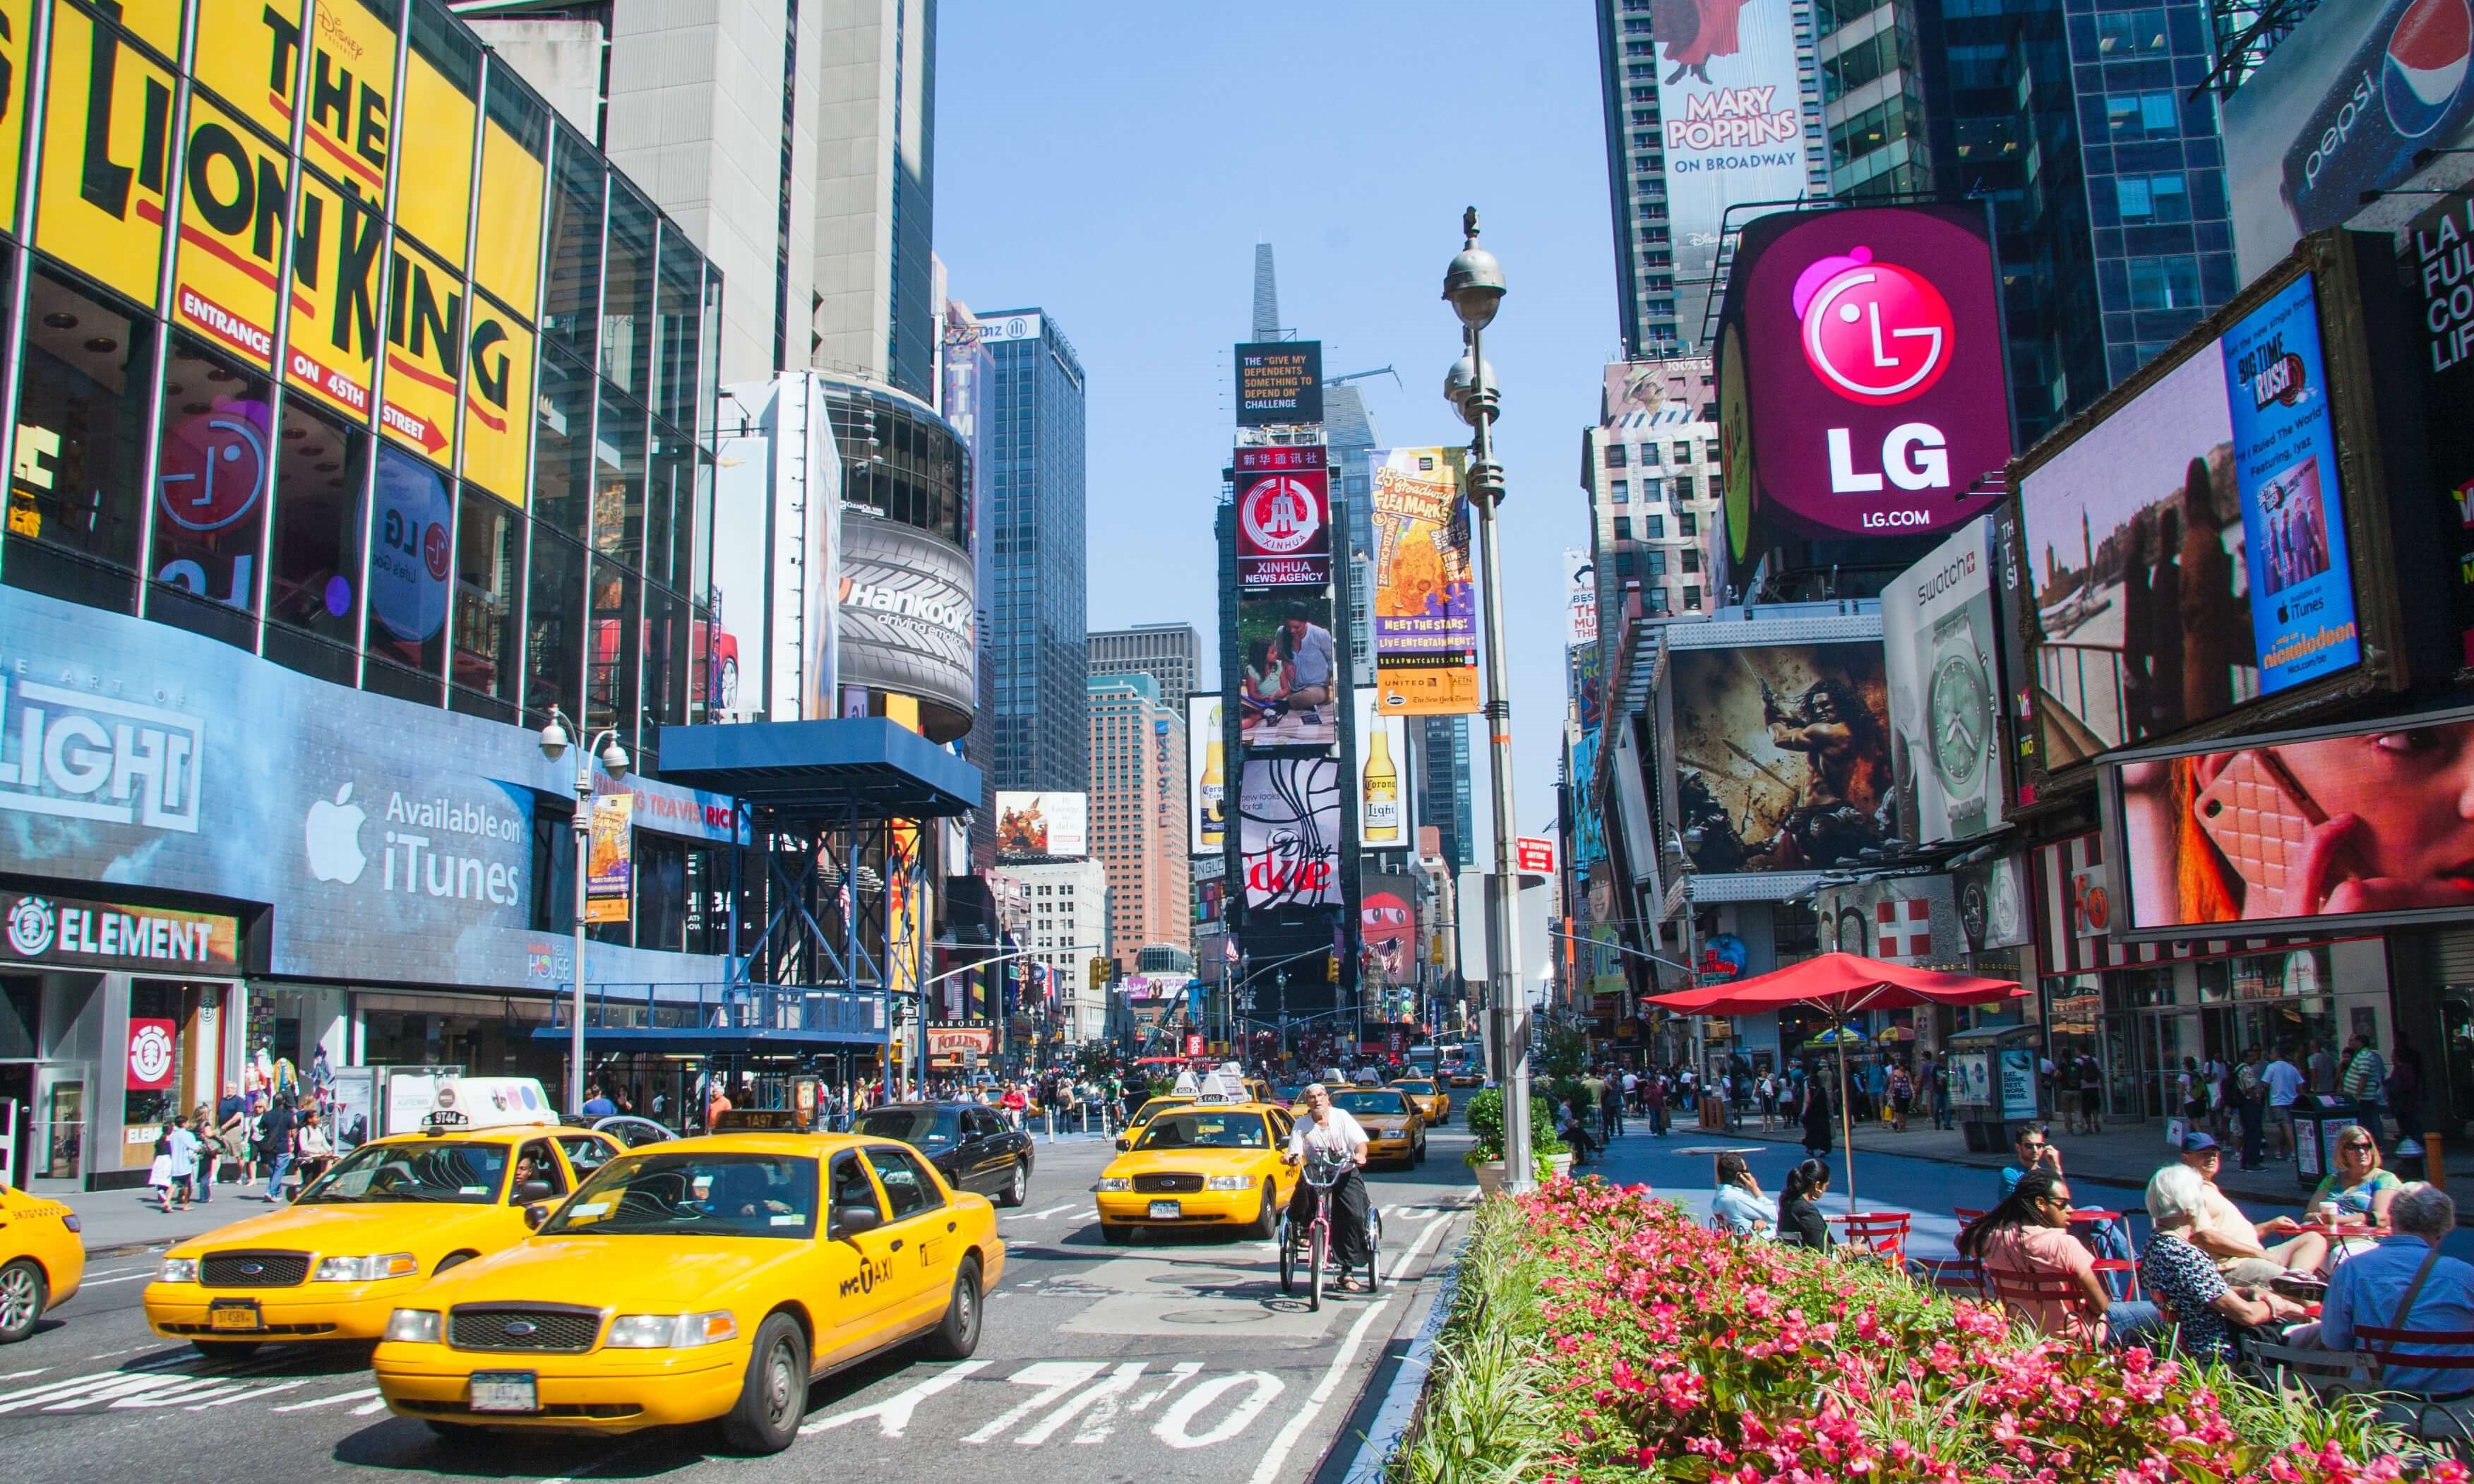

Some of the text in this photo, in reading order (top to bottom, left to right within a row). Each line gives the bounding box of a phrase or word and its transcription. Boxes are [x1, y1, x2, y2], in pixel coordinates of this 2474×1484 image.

[263, 5, 389, 171] THE
[1686, 85, 1778, 121] MARY
[1666, 109, 1798, 150] POPPINS
[2305, 69, 2374, 191] pepsi
[80, 0, 323, 292] LION
[1675, 152, 1796, 174] ON BROADWAY
[332, 176, 510, 411] KING
[184, 293, 270, 356] ENTRANCE
[2269, 308, 2292, 329] single
[1244, 357, 1262, 366] THE
[1292, 355, 1307, 365] MY
[1244, 366, 1303, 376] DEPENDENTS
[294, 356, 365, 408] ON 45TH
[1245, 376, 1312, 388] SOMETHING TO
[1245, 388, 1281, 398] DEPEND
[2254, 356, 2290, 405] RUSH
[1245, 399, 1297, 409] CHALLENGE
[382, 405, 425, 442] STREET
[2252, 433, 2276, 455] Ruled
[2276, 426, 2293, 441] The
[1243, 452, 1318, 466] 新华通讯社
[1827, 422, 1950, 493] LG
[1372, 489, 1456, 524] FLEA MARKET
[1863, 510, 1930, 528] LG.COM
[1263, 534, 1305, 550] XINHUA
[1245, 572, 1323, 583] NEWS AGENCY
[1257, 561, 1311, 573] XINHUA
[1917, 558, 1967, 607] swatch
[1573, 593, 1594, 603] BES
[2290, 597, 2324, 620] iTunes
[876, 611, 967, 648] driving emotion
[1385, 618, 1469, 631] MEET THE STARS!
[1379, 635, 1475, 648] LIVE ENTERTAINMENT!
[2264, 621, 2355, 671] nickelodeon
[1156, 738, 1167, 828] NOVOTEL
[1365, 779, 1396, 790] Corona
[649, 794, 702, 822] TRAVIS
[1241, 791, 1281, 803] new looks
[1253, 802, 1263, 810] fall
[386, 791, 521, 844] Available on
[1368, 803, 1395, 818] Light
[383, 830, 520, 907] iTunes
[58, 907, 214, 962] ELEMENT
[435, 1113, 458, 1125] 9T44
[745, 1113, 773, 1128] 1A97
[131, 1129, 162, 1142] ELEM
[839, 1257, 893, 1300] NYC TAXI
[798, 1358, 1286, 1449] ONLY
